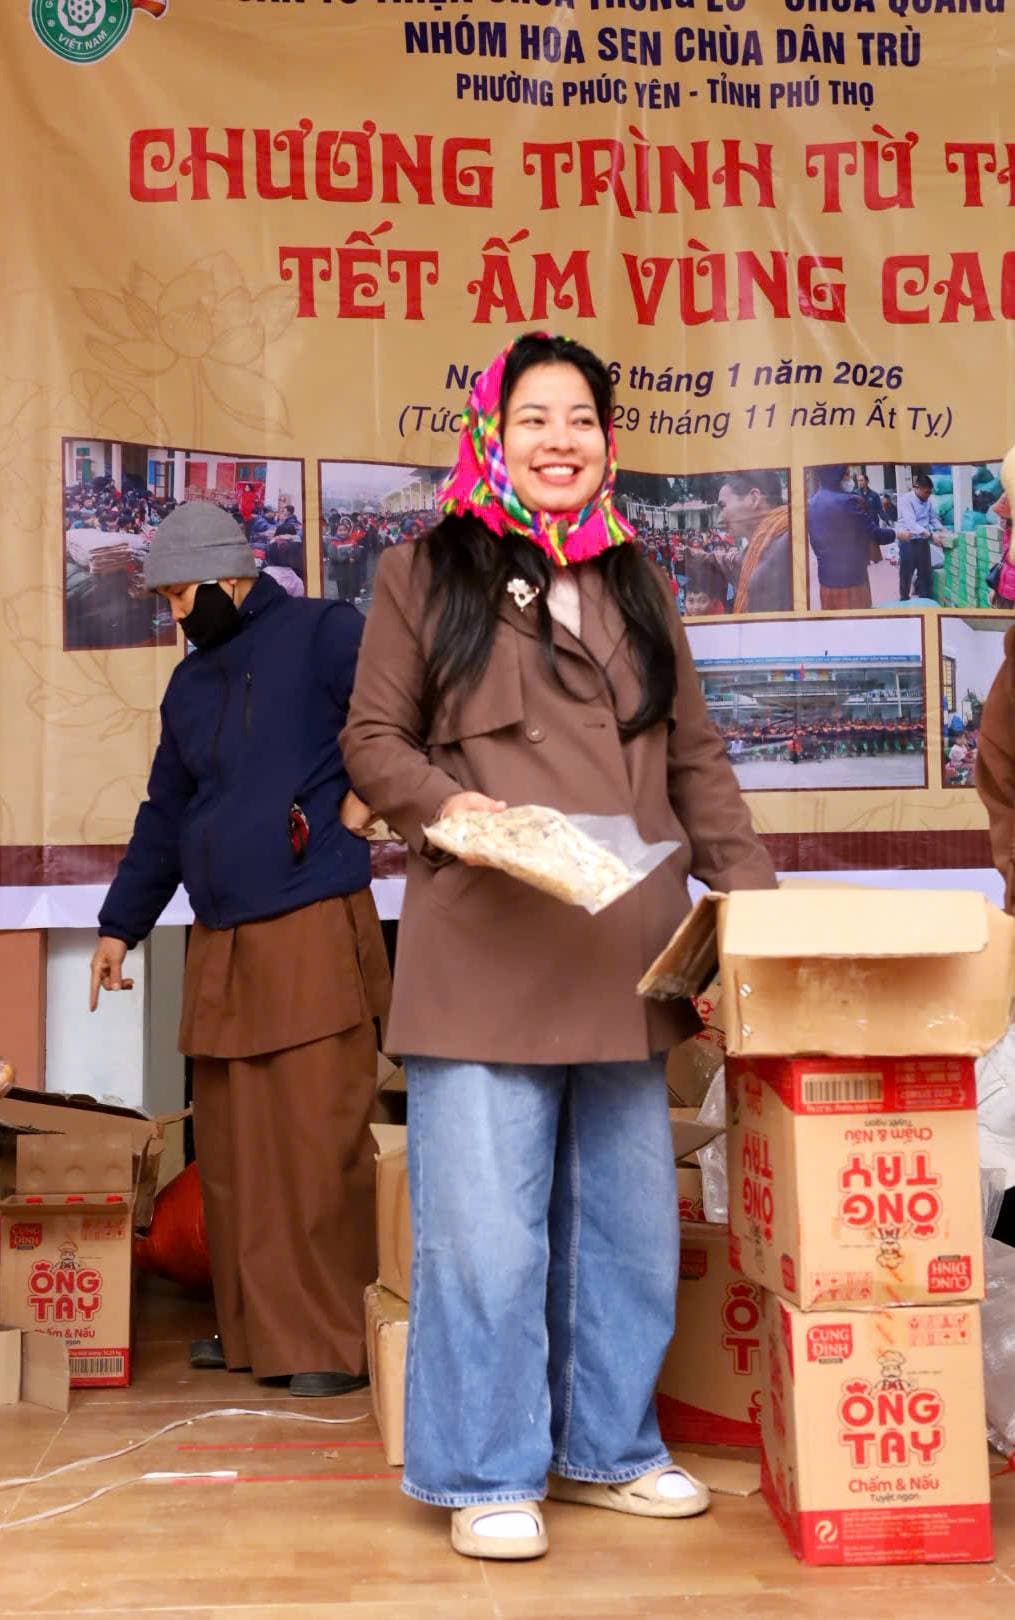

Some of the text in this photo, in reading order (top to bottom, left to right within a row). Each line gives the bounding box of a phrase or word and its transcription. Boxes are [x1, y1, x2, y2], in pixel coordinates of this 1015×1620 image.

[85, 30, 108, 50] NAM
[404, 13, 921, 67] NHÓM HOA SEN CHÙA DÂN TRÙ
[456, 71, 554, 107] PHƯỜNG
[562, 72, 628, 107] PHÚC
[634, 78, 681, 110] YÊN
[706, 71, 761, 109] TỈNH
[770, 74, 820, 109] PHÚ
[828, 79, 875, 112] THỌ
[129, 117, 494, 209] CHƯƠNG
[522, 124, 776, 220] TRÌNH
[805, 123, 920, 213] TỪ
[278, 220, 1015, 326] TẾT ẤM VÙNG CA
[629, 365, 714, 398] tháng
[728, 362, 741, 388] 1
[753, 359, 823, 386] năm
[832, 361, 904, 390] 2026
[649, 409, 731, 439] tháng
[746, 403, 777, 429] 11
[790, 401, 856, 427] năm
[865, 396, 897, 430] Ất
[878, 1129, 888, 1143] &
[842, 1193, 940, 1237] ÔNG
[30, 1263, 100, 1294] ÔNG
[929, 1274, 969, 1290] CUNG
[809, 1328, 849, 1342] CUNG
[841, 1381, 941, 1428] ÔNG
[848, 1473, 940, 1493] Chấm & Nấu
